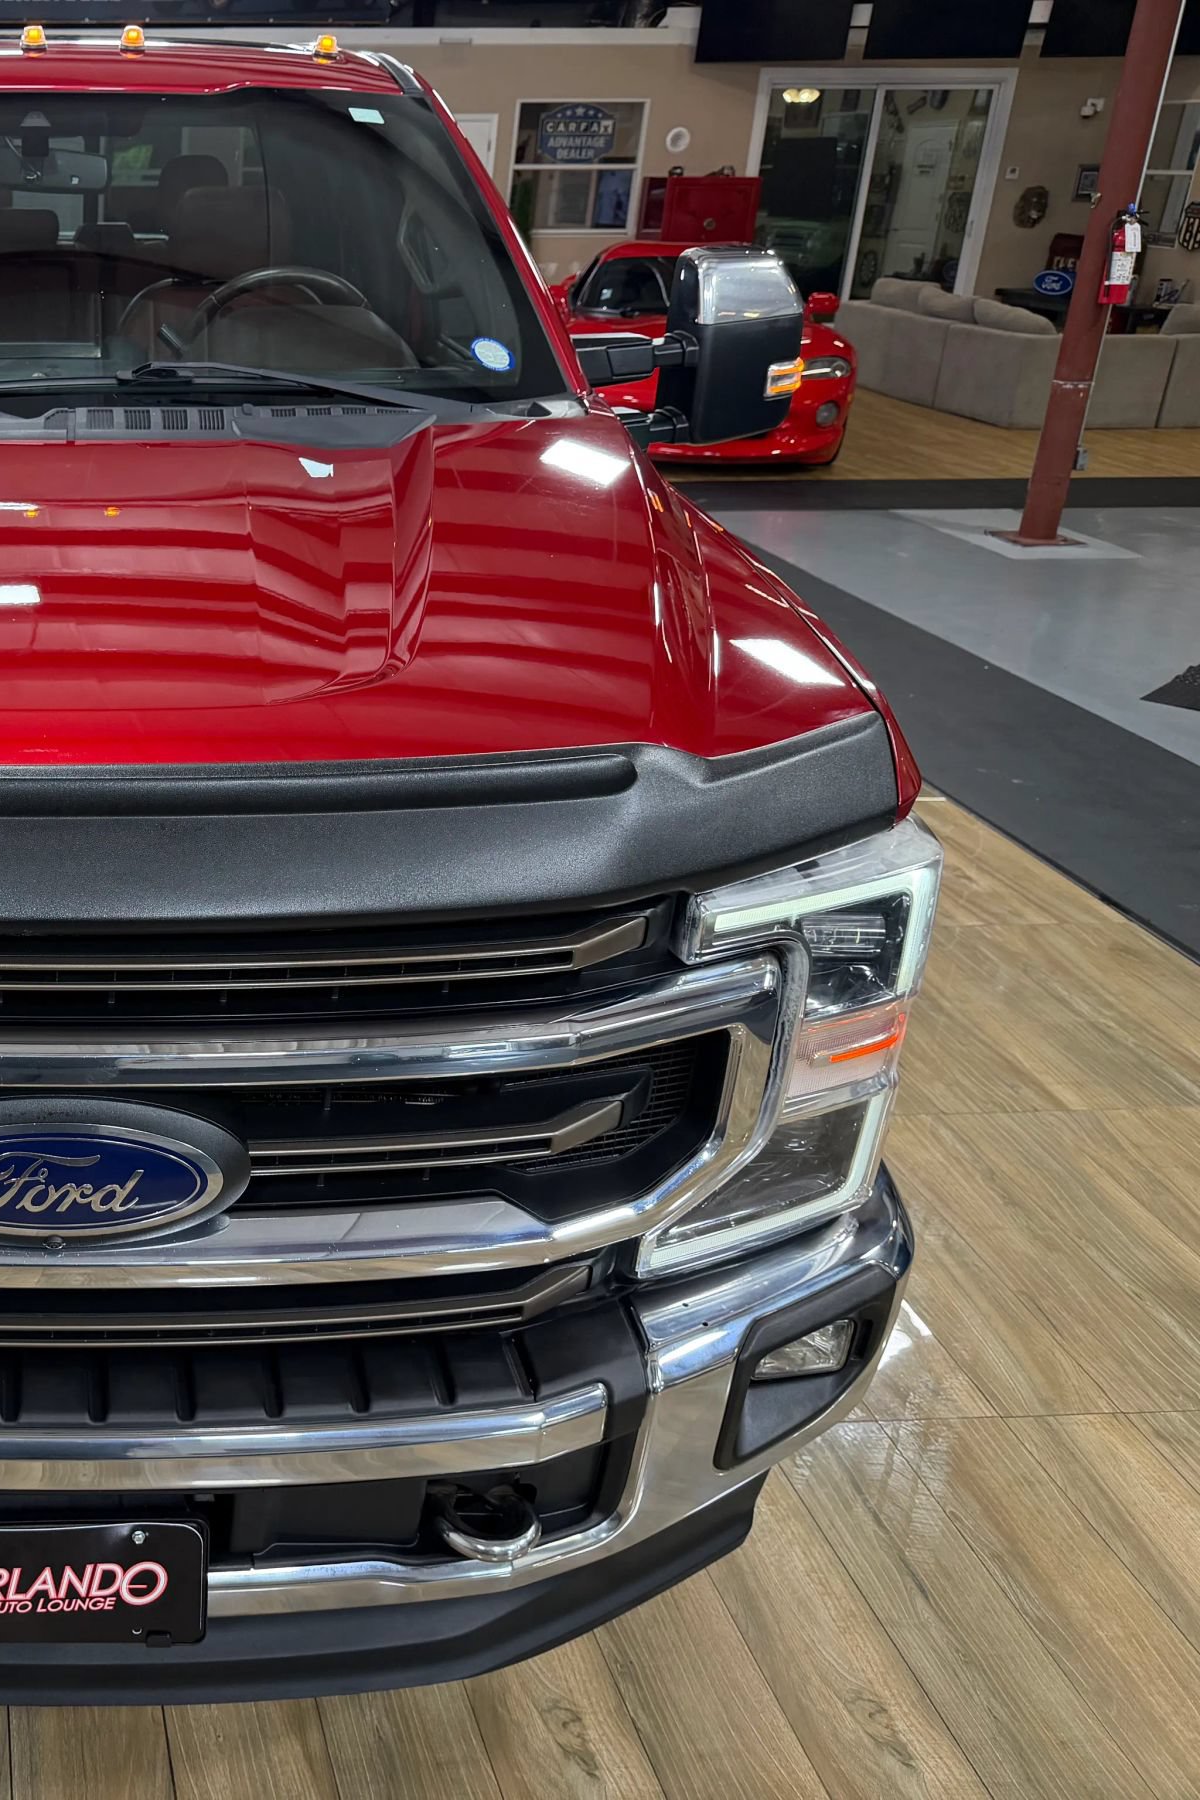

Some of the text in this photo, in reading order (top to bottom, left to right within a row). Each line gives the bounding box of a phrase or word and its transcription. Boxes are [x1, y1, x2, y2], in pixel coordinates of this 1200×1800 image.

[546, 120, 614, 134] CARFAX
[547, 136, 606, 149] ADVANTAGE
[555, 149, 595, 160] DEALER
[36, 1597, 117, 1613] LOUNGE
